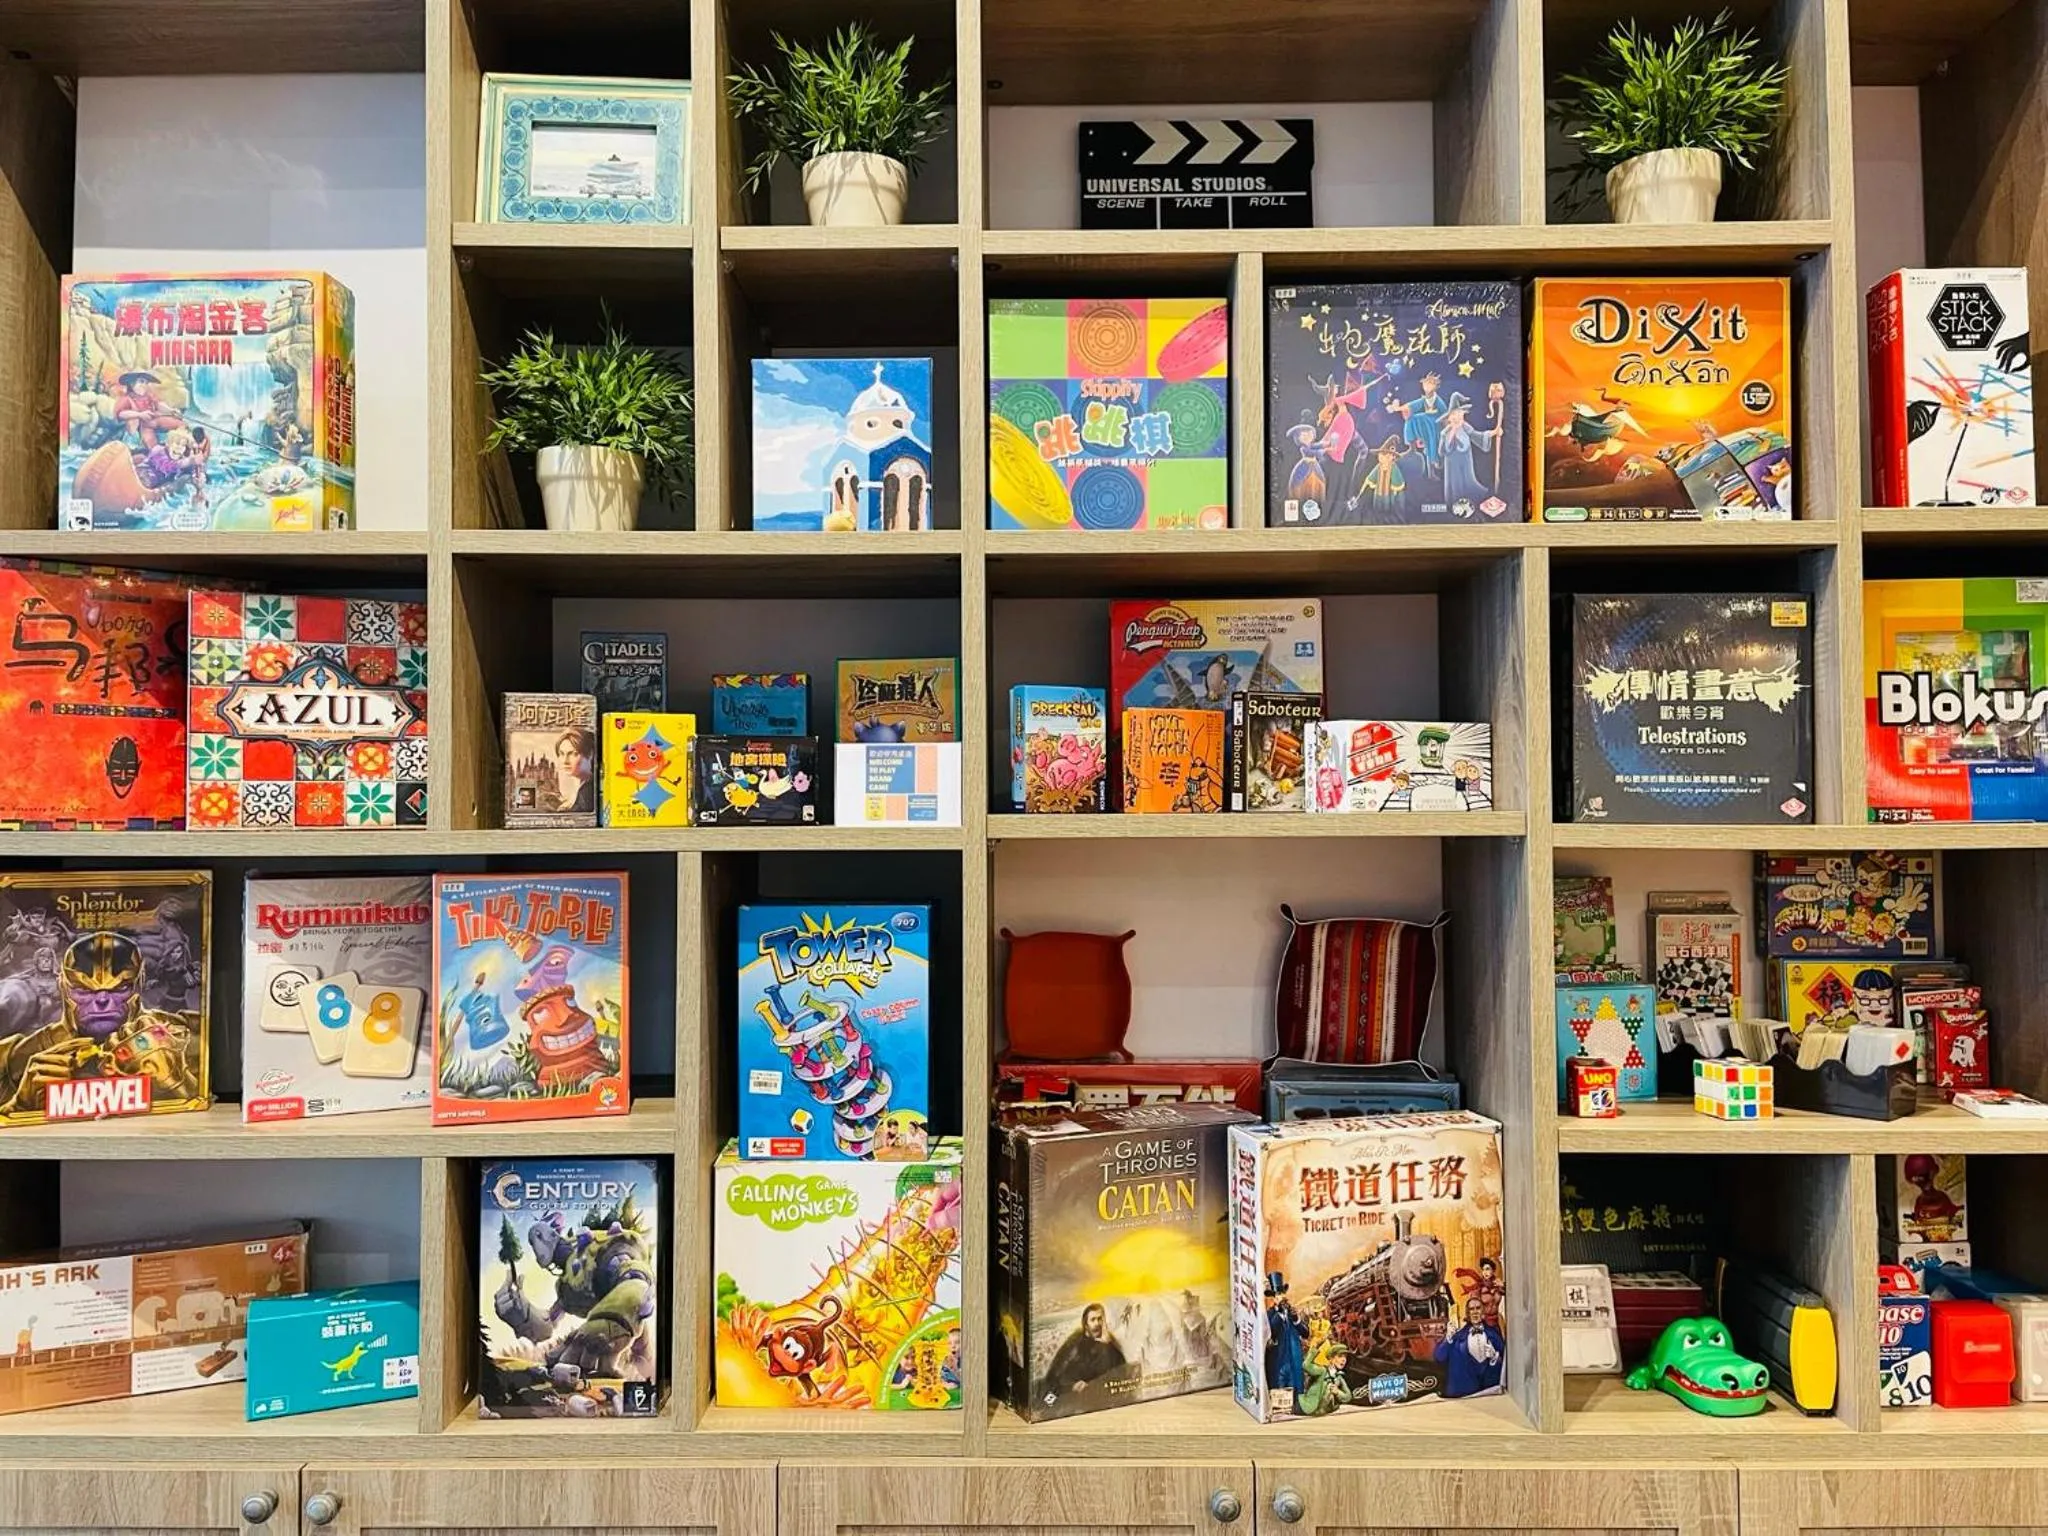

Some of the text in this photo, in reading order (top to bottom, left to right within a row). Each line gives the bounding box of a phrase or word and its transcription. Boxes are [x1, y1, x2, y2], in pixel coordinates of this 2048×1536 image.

[1086, 177, 1267, 193] UNIVERSAL STUDIOS
[1097, 198, 1146, 208] SCENE
[1175, 198, 1213, 208] TAKE
[1249, 197, 1288, 207] ROLL
[1941, 300, 1991, 316] STICK
[1938, 317, 1994, 333] STACK
[150, 339, 233, 368] NIAGARA
[1126, 621, 1174, 641] Penguin
[1174, 620, 1202, 639] Trap
[583, 642, 663, 665] CITADELS
[255, 695, 383, 727] AZUL
[517, 703, 591, 726] 阿瓦隆
[1031, 701, 1096, 719] DRECKSAU
[1248, 699, 1321, 717] Saboteur
[1637, 726, 1747, 745] Telestrations
[1233, 729, 1244, 788] Saboteur
[1976, 766, 1994, 774] Great
[2006, 766, 2035, 774] Families!
[56, 892, 144, 917] Splendor
[256, 902, 432, 940] Rummikub
[527, 891, 614, 945] TOPPLE
[897, 919, 916, 927] 707
[760, 926, 893, 979] TOWER
[811, 962, 881, 983] COLLAPSE
[1908, 991, 1958, 1005] MONOPOLY
[1584, 1072, 1613, 1084] UNO
[48, 1078, 149, 1117] MARVEL
[1103, 1139, 1194, 1158] A GAME OF
[1100, 1152, 1197, 1184] THRONES
[493, 1170, 637, 1210] CENTURY
[730, 1183, 809, 1203] FALLING
[1300, 1155, 1468, 1212] 鐵道任務
[771, 1193, 858, 1224] MONKEYS
[1098, 1178, 1196, 1222] CATAN
[998, 1182, 1010, 1271] CATAN
[1302, 1215, 1345, 1233] TICKET
[1358, 1211, 1386, 1227] RIDE
[55, 1263, 101, 1284] ARK
[1889, 1387, 1904, 1407] 8
[1904, 1374, 1932, 1403] 10
